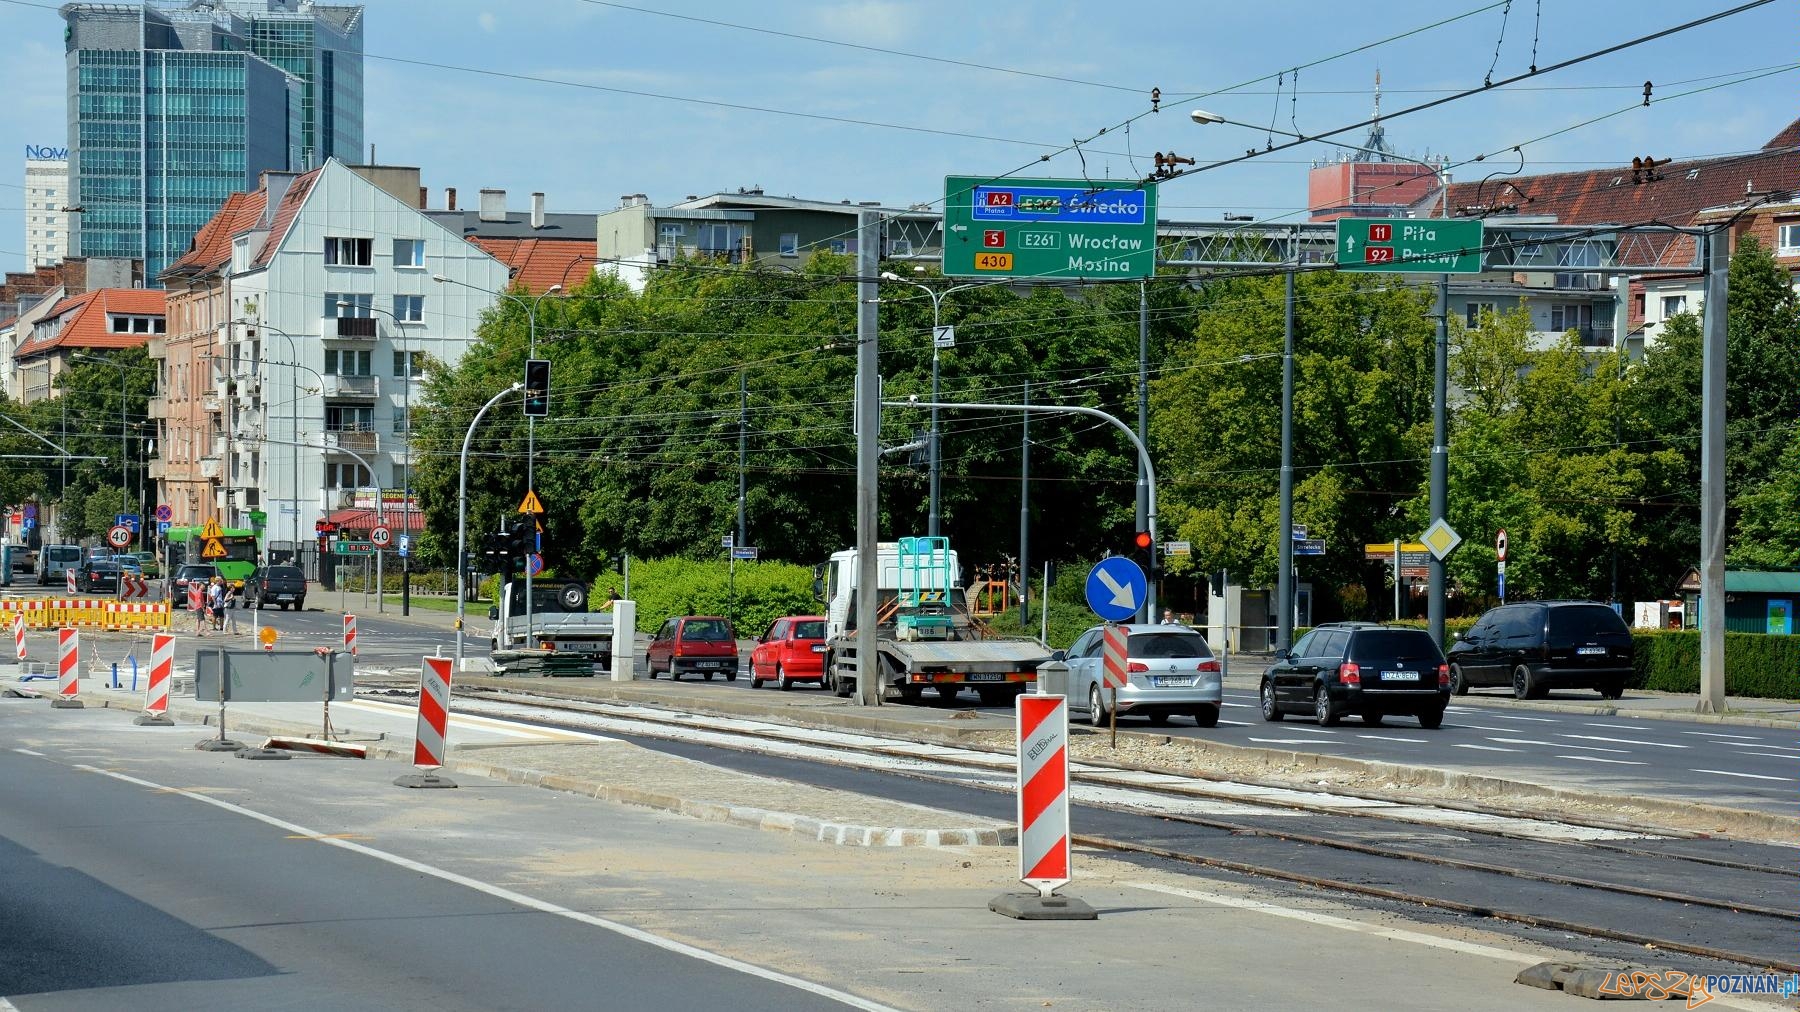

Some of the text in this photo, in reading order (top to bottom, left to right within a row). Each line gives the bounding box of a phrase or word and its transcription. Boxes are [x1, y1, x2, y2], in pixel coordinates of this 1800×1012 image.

[992, 194, 1008, 205] A2
[1375, 226, 1436, 241] 11 Piła
[990, 233, 1142, 250] 5 E261 Wrocław
[1371, 249, 1388, 262] 92
[981, 255, 1130, 272] 430 Mosina
[111, 531, 128, 542] 40
[373, 531, 389, 541] 40
